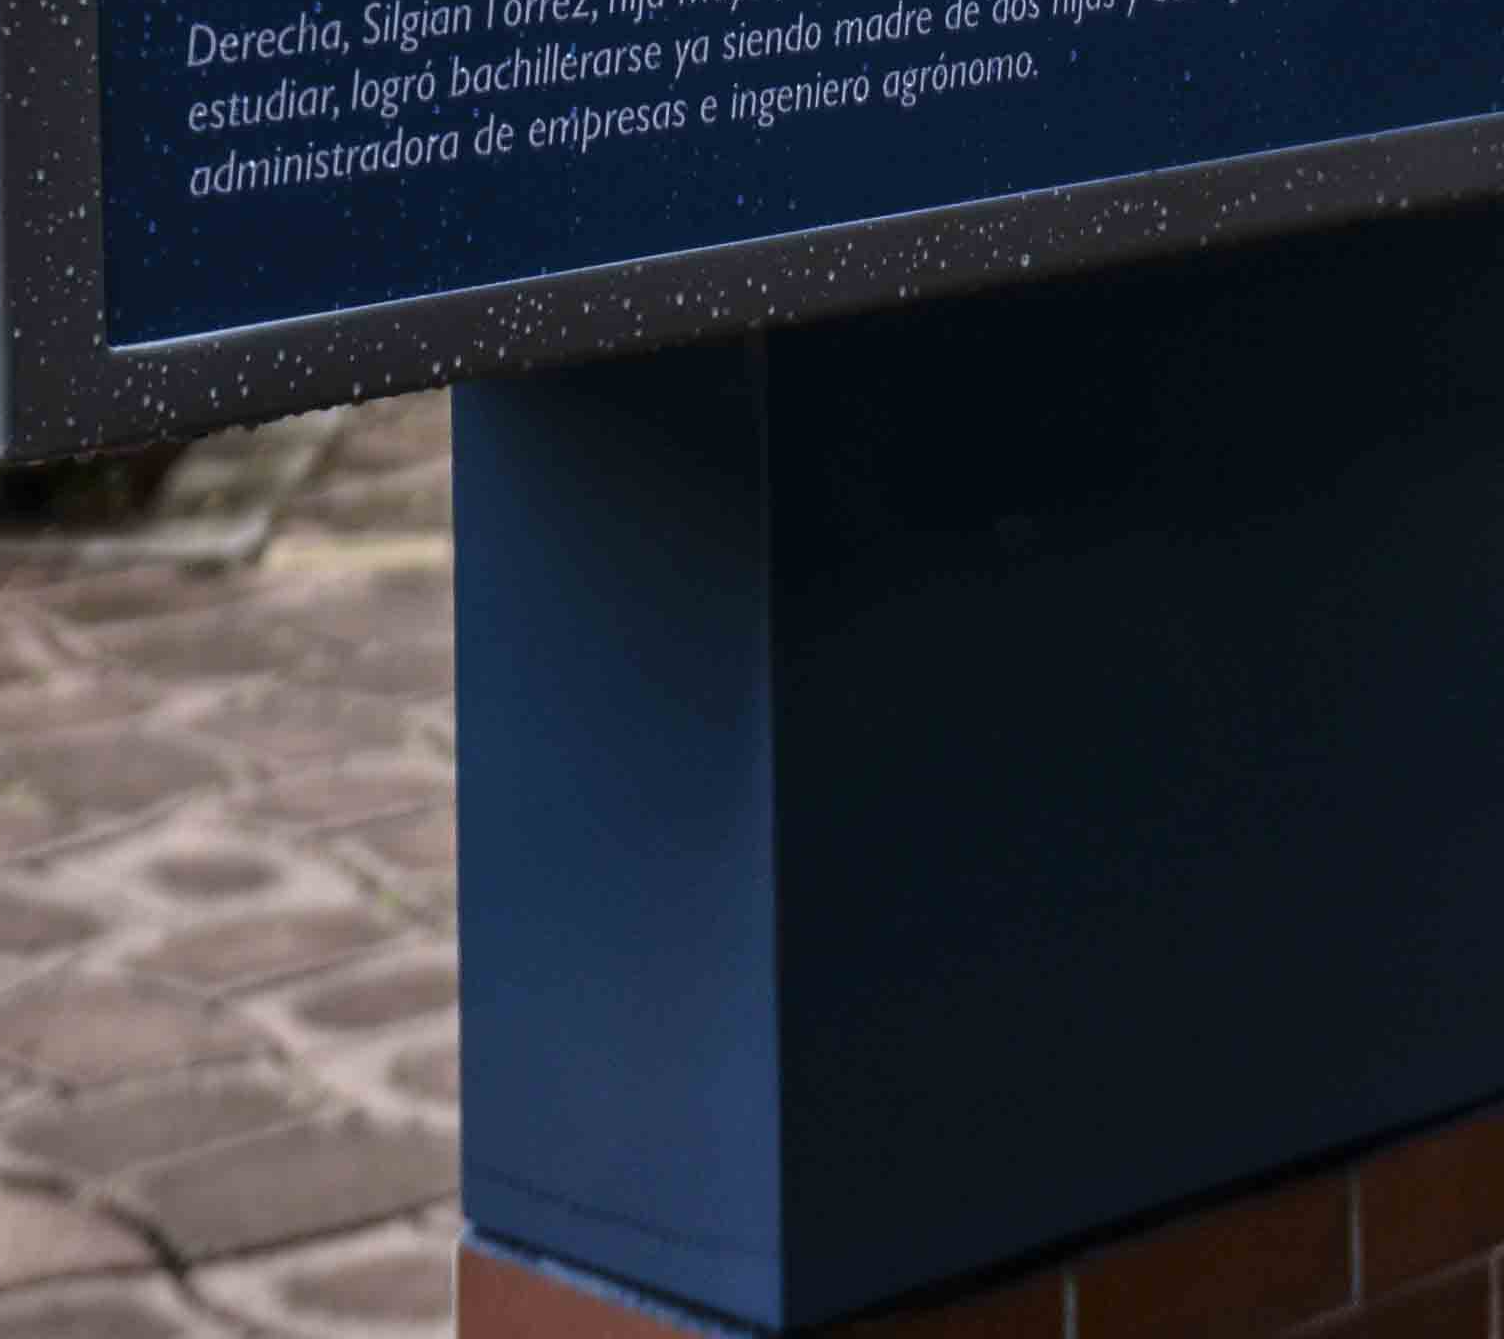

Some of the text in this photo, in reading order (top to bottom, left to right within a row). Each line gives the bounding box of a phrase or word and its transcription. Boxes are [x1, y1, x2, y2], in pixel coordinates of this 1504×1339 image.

[185, 11, 351, 69] Derecha,
[188, 77, 341, 133] estudiar,
[351, 58, 439, 119] logró
[450, 41, 663, 99] bachillerarse
[674, 34, 711, 79] ya
[721, 10, 823, 62] siendo
[188, 50, 1039, 198] administradora de empresas e ingeniero agrónomo.
